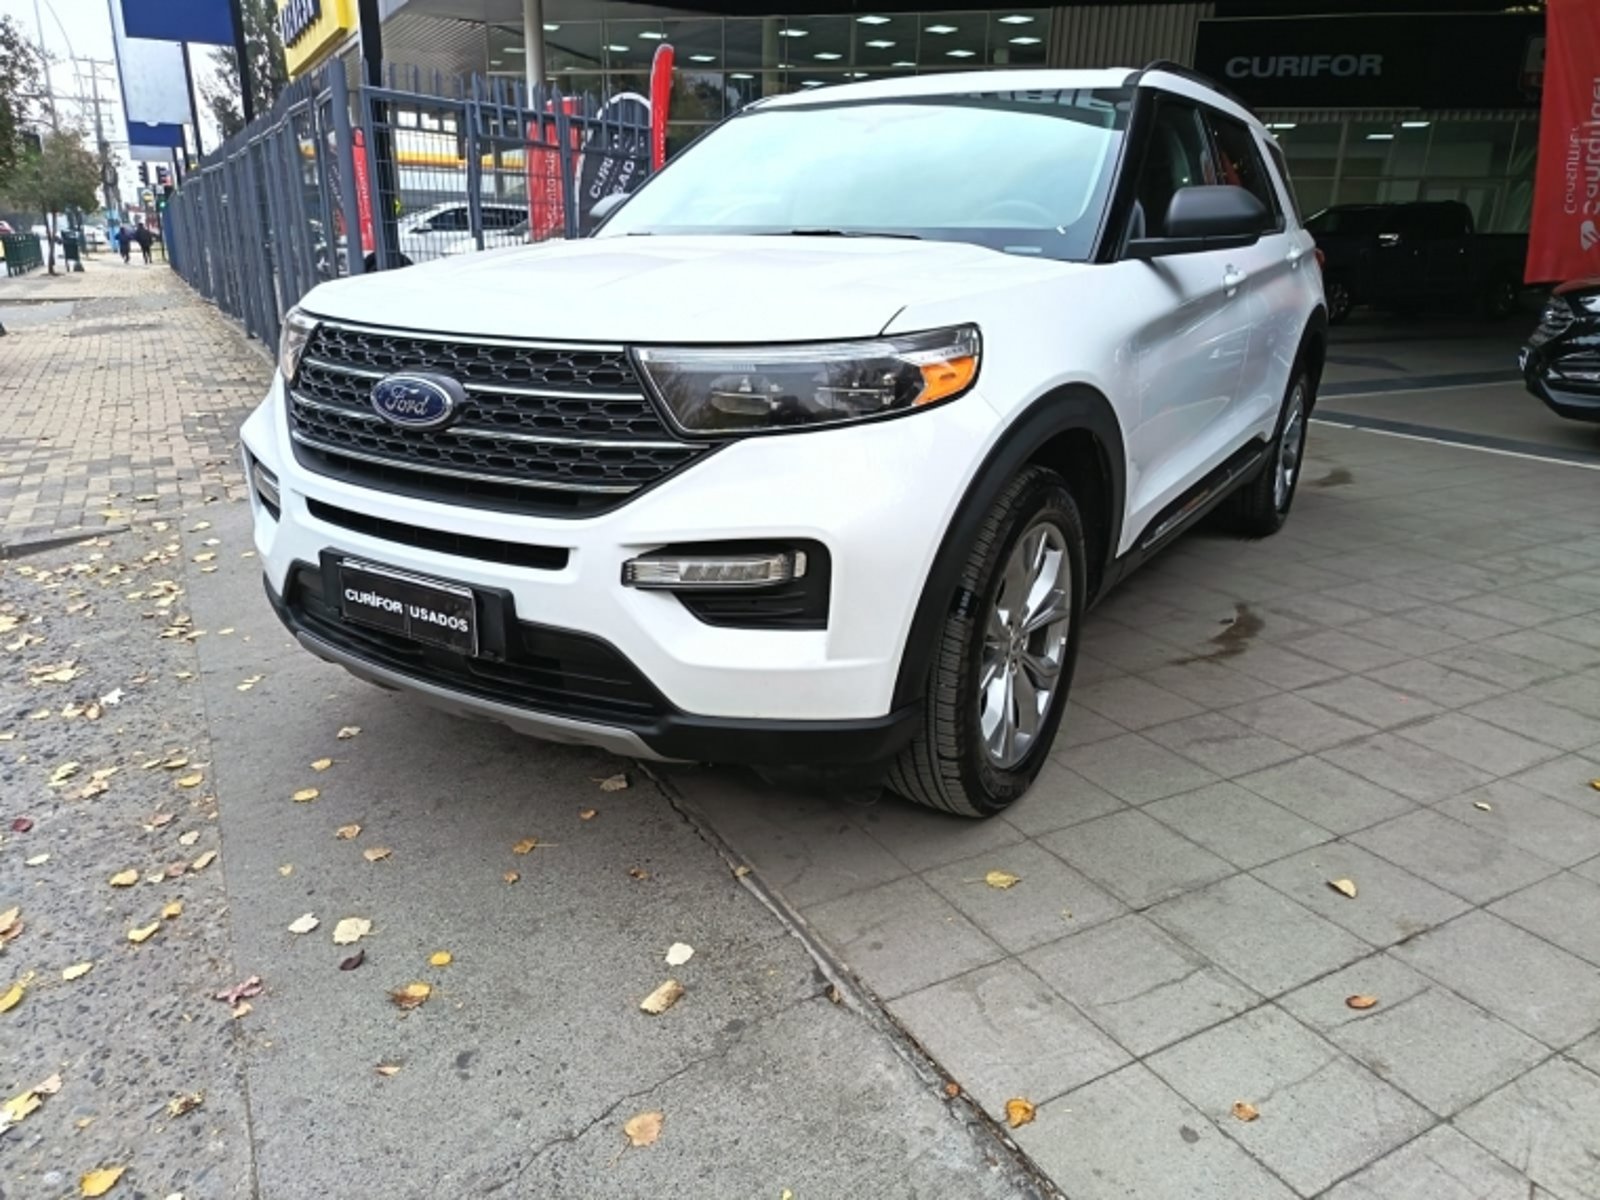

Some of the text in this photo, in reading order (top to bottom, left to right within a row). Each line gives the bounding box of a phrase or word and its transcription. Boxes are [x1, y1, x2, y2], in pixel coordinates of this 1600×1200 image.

[1225, 54, 1383, 78] CURIFOR
[384, 385, 430, 415] Ford
[410, 605, 468, 632] USADOS
